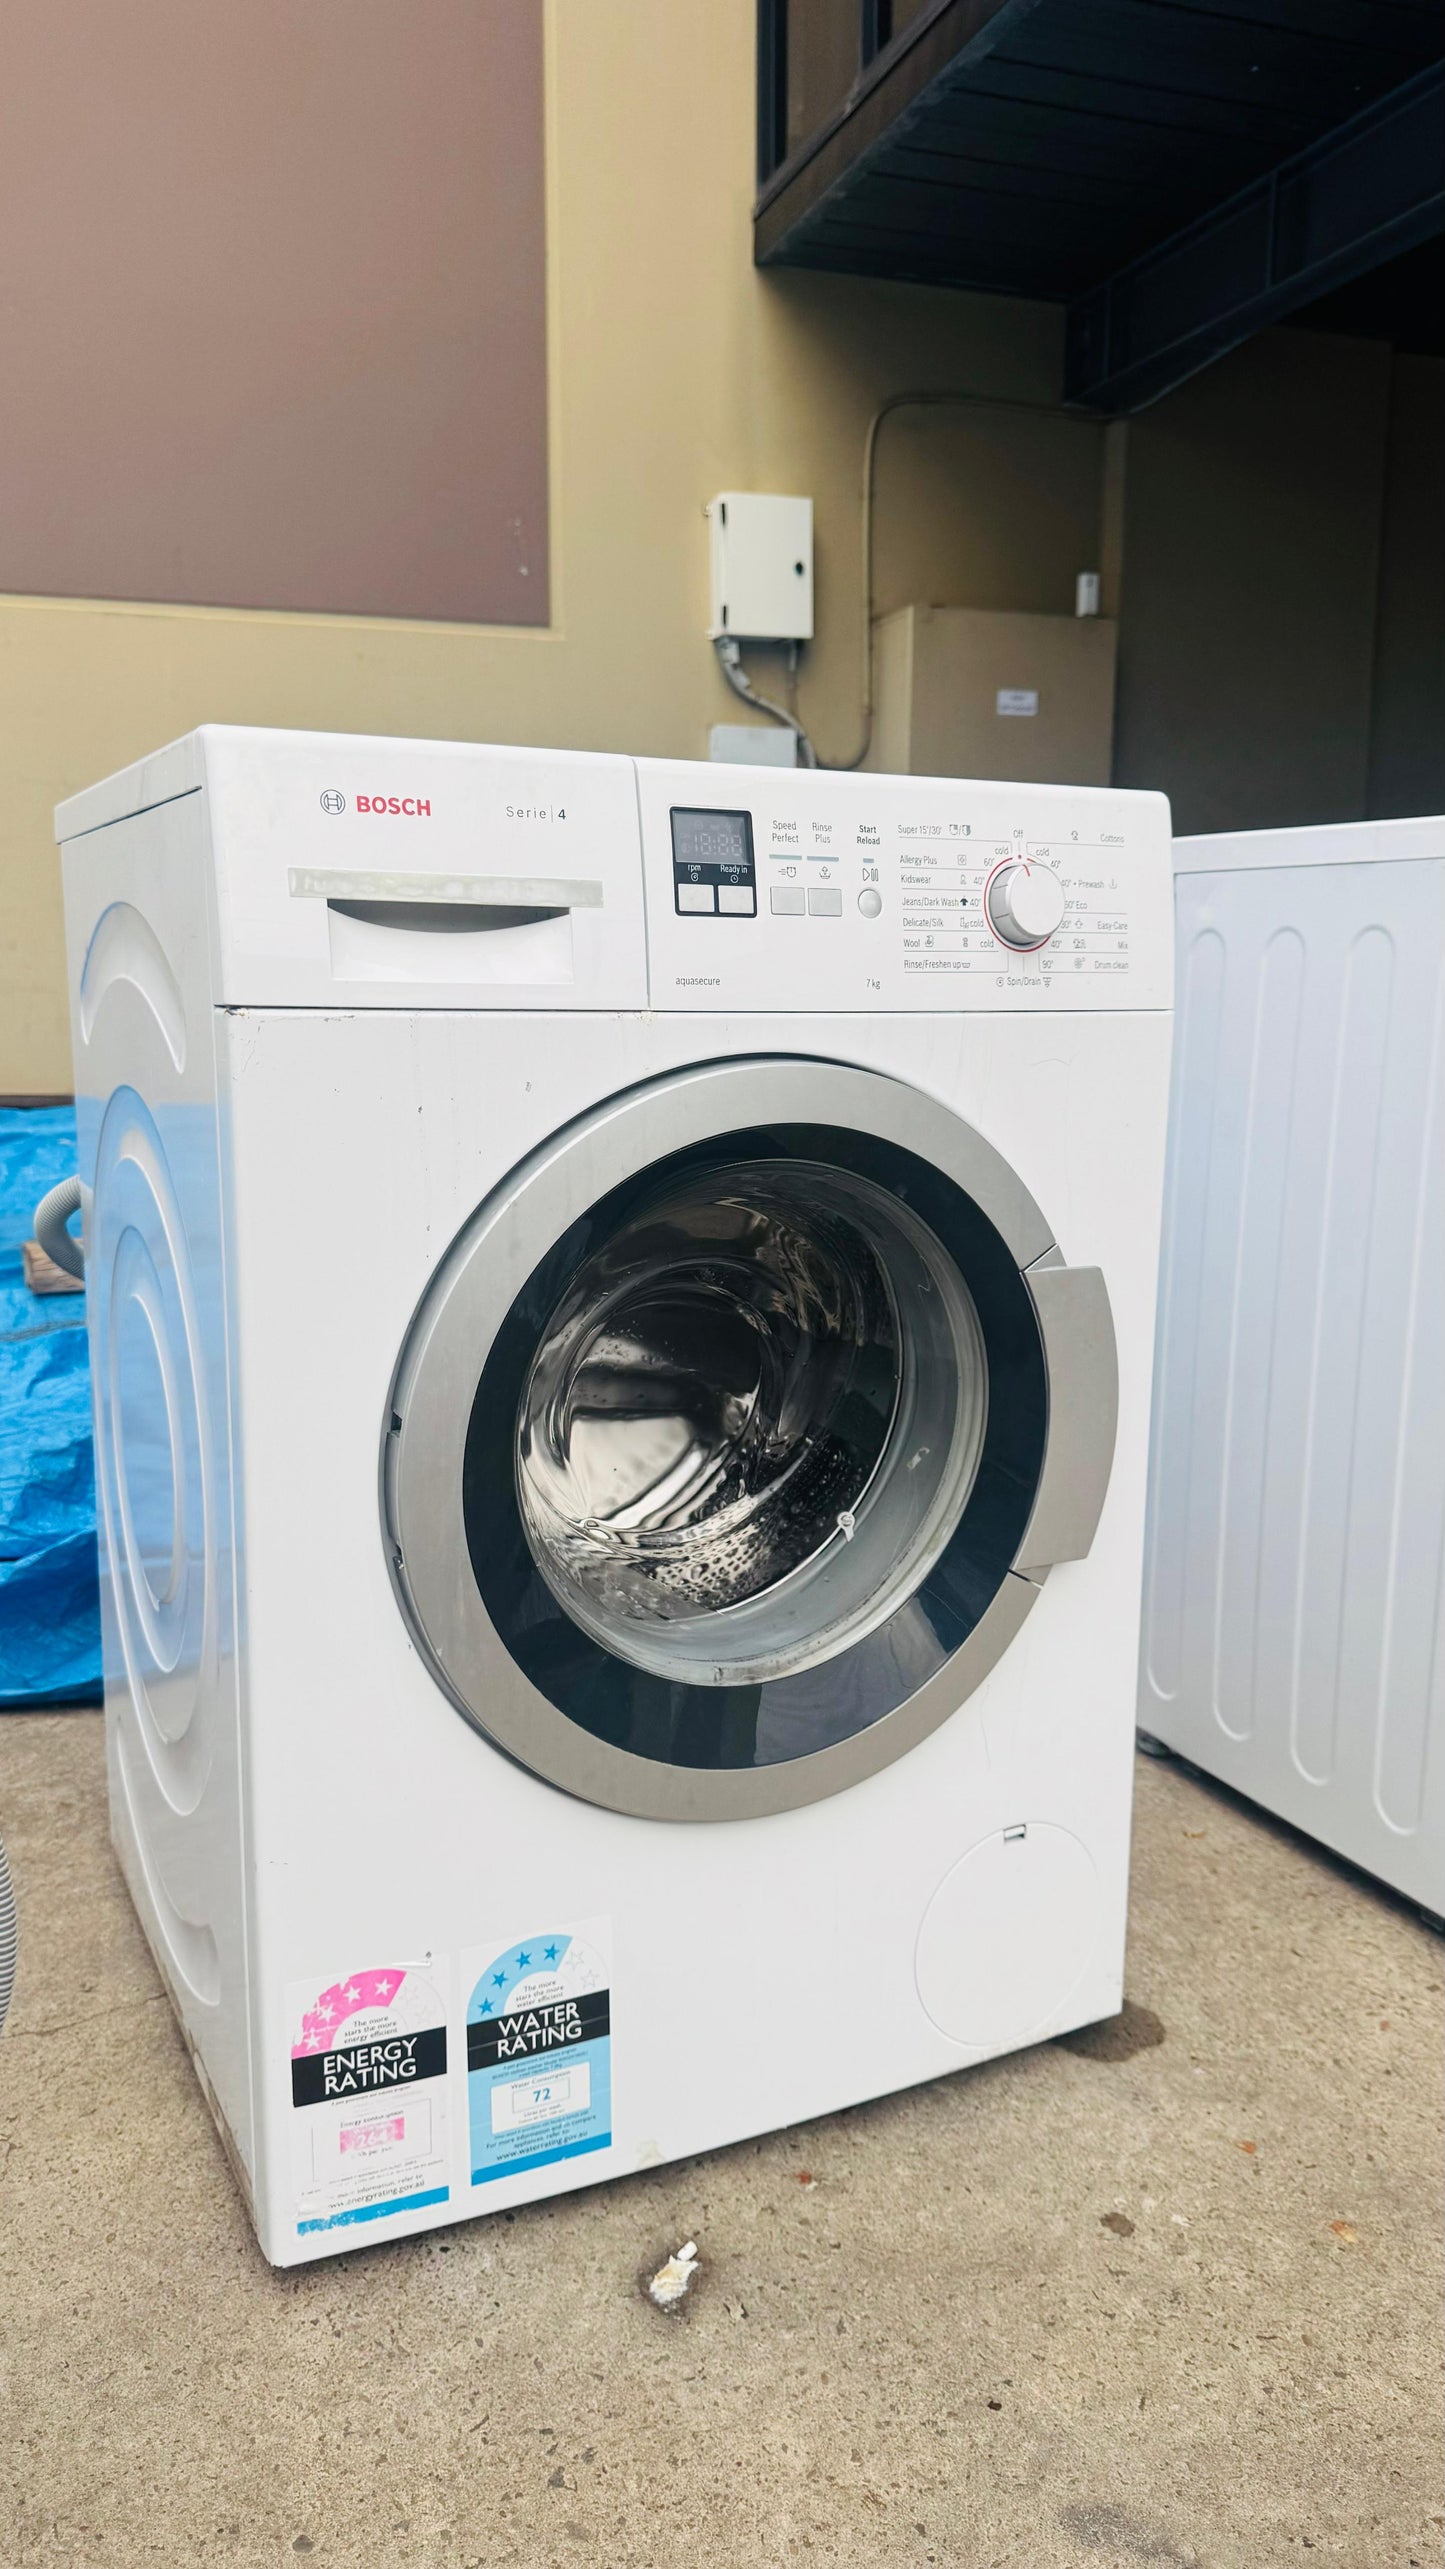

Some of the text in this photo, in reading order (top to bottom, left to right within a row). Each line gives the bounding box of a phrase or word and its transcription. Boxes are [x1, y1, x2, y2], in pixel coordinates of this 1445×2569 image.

[356, 795, 431, 817] BOSCH
[506, 806, 566, 820] Serie 4
[772, 820, 797, 831] Speed
[812, 822, 832, 832] Rinse
[859, 825, 877, 834] Start
[898, 825, 918, 835] Super
[772, 833, 799, 844] Perfect
[815, 834, 831, 844] Plus
[1013, 829, 1024, 839] Off
[1100, 834, 1125, 844] Cottons
[856, 836, 880, 846] Reload
[995, 846, 1009, 855] cold
[1036, 848, 1050, 857] cold
[900, 855, 938, 866] Allergy Plus
[688, 865, 701, 873] rpm
[720, 865, 748, 875] Ready in
[900, 875, 932, 884] Kidswear
[1078, 879, 1104, 889] Prewash
[902, 897, 960, 907] Jeans/Dark Wash
[1076, 901, 1088, 910] Eco
[903, 917, 944, 928] Delicate/Silk
[970, 918, 984, 928] cold
[904, 939, 921, 948] Wool
[980, 939, 994, 949] cold
[1117, 941, 1128, 950] Mix
[904, 959, 961, 970] Rinse/Freshen up
[1094, 960, 1112, 970] Drum
[675, 976, 721, 988] aquasecure
[866, 979, 881, 990] 7 kg
[1007, 976, 1041, 987] Spin/Drain
[524, 1985, 537, 1993] The
[353, 2020, 368, 2028] The
[498, 2002, 580, 2037] WATER
[497, 2019, 582, 2059] RATING
[323, 2037, 418, 2076] ENERGY
[325, 2058, 417, 2096] RATING
[533, 2087, 552, 2103] 72
